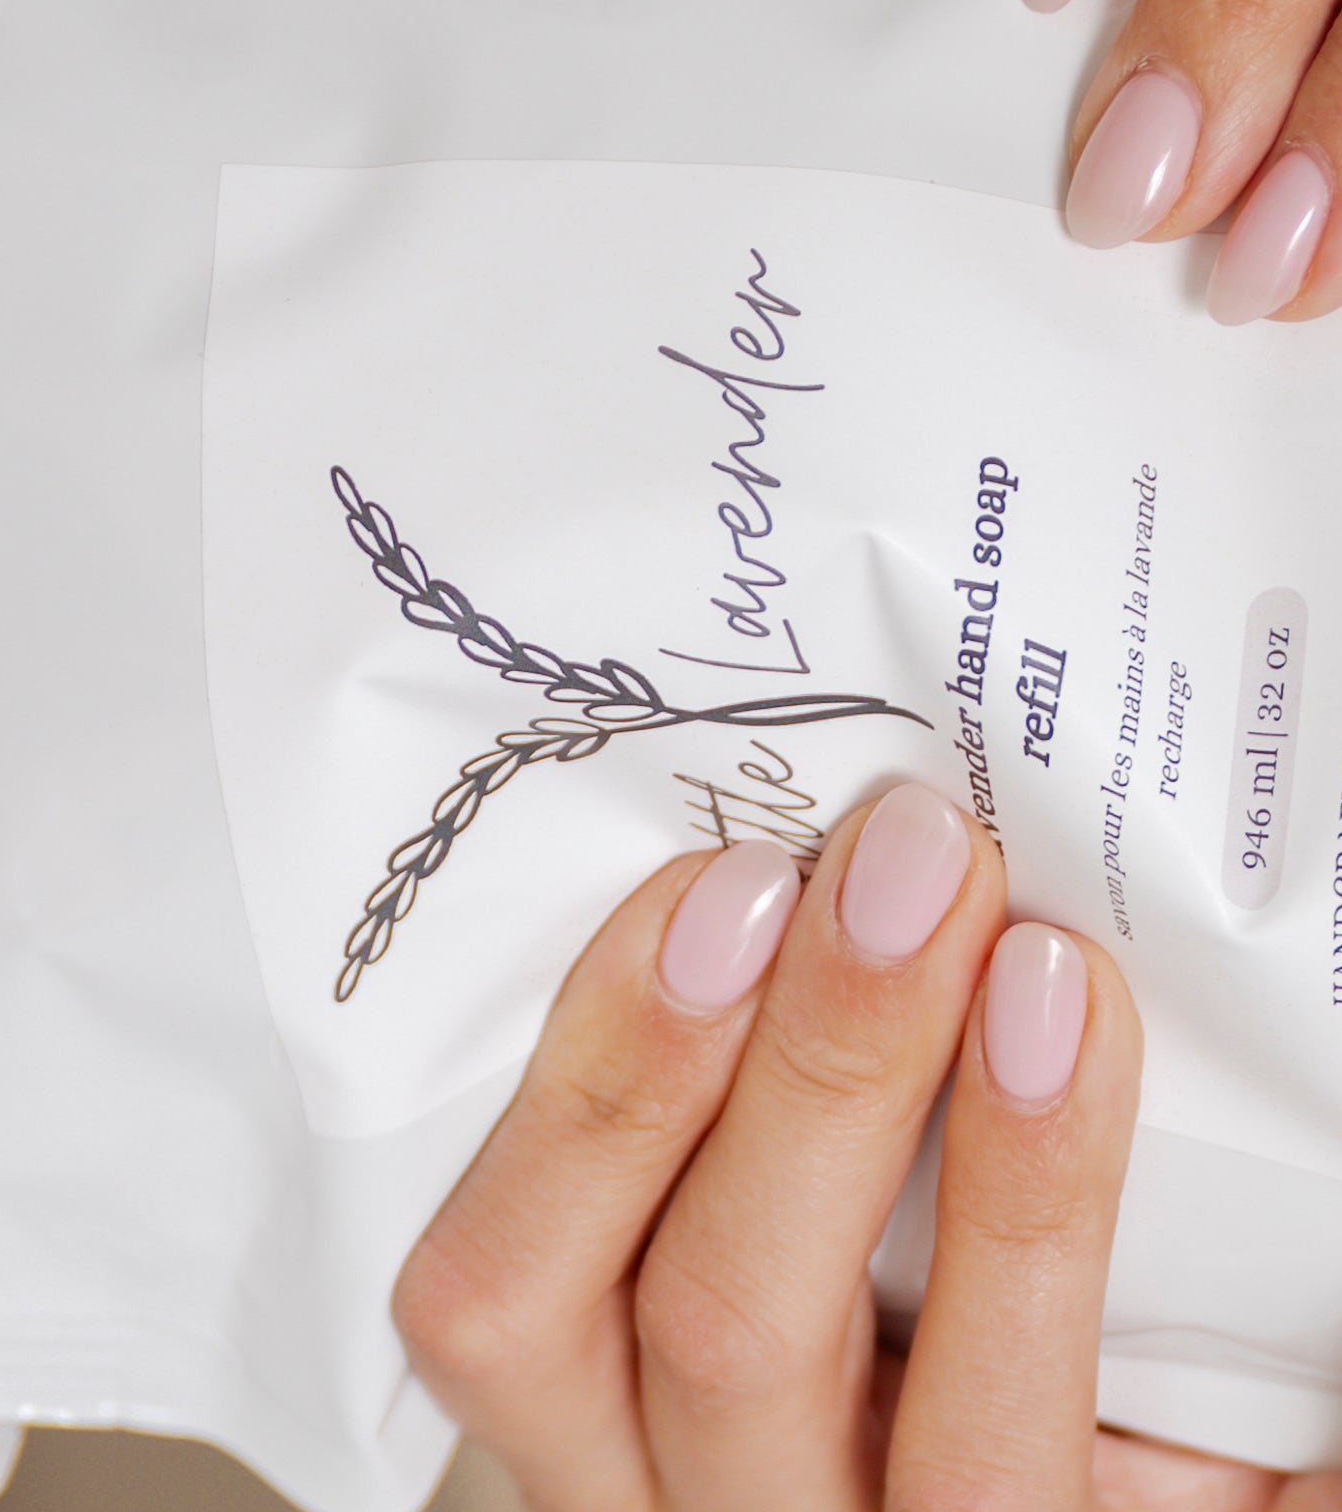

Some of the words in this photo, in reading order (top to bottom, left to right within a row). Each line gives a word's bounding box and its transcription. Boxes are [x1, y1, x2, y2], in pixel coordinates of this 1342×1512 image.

[656, 247, 826, 676] Lavender
[972, 455, 1020, 569] soap
[1124, 463, 1158, 587] lavande
[943, 577, 1000, 707] hand
[1120, 624, 1147, 644] à
[1122, 590, 1149, 622] la
[1265, 627, 1291, 671] oz
[1014, 637, 1069, 769] refill
[1116, 647, 1145, 747] mains
[1156, 660, 1193, 801] recharge
[1256, 681, 1286, 722] 32
[670, 737, 826, 863] ttle
[952, 706, 1005, 858] vender
[1099, 752, 1133, 803] les
[1244, 747, 1280, 798] ml
[1102, 802, 1127, 878] pour
[1241, 807, 1272, 870] 946
[1106, 876, 1134, 942] savon
